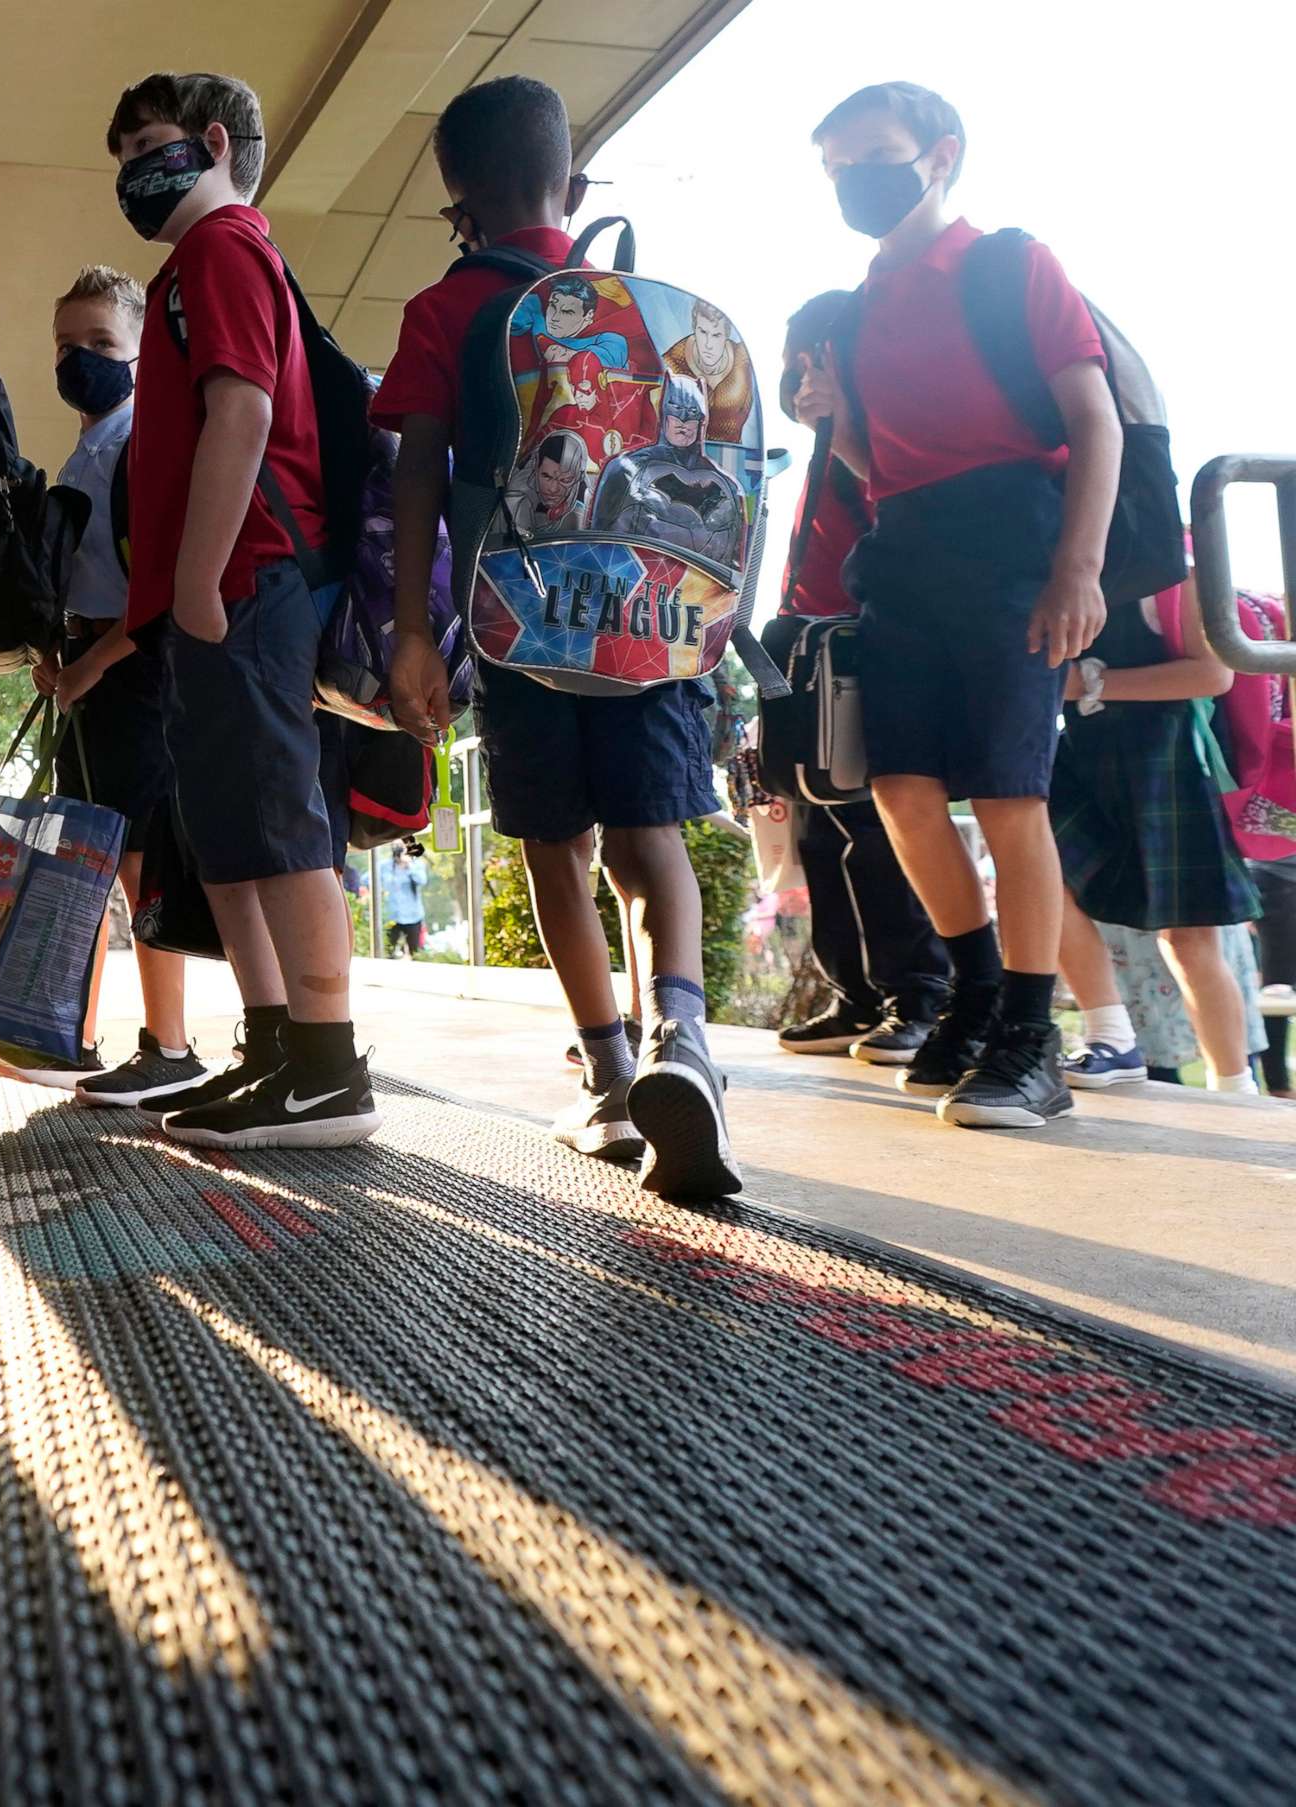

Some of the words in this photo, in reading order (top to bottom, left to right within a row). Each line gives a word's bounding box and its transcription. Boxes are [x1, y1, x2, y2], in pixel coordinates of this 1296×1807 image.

[562, 570, 629, 599] JOIN
[642, 579, 683, 608] THE
[543, 584, 704, 647] LEAGUE
